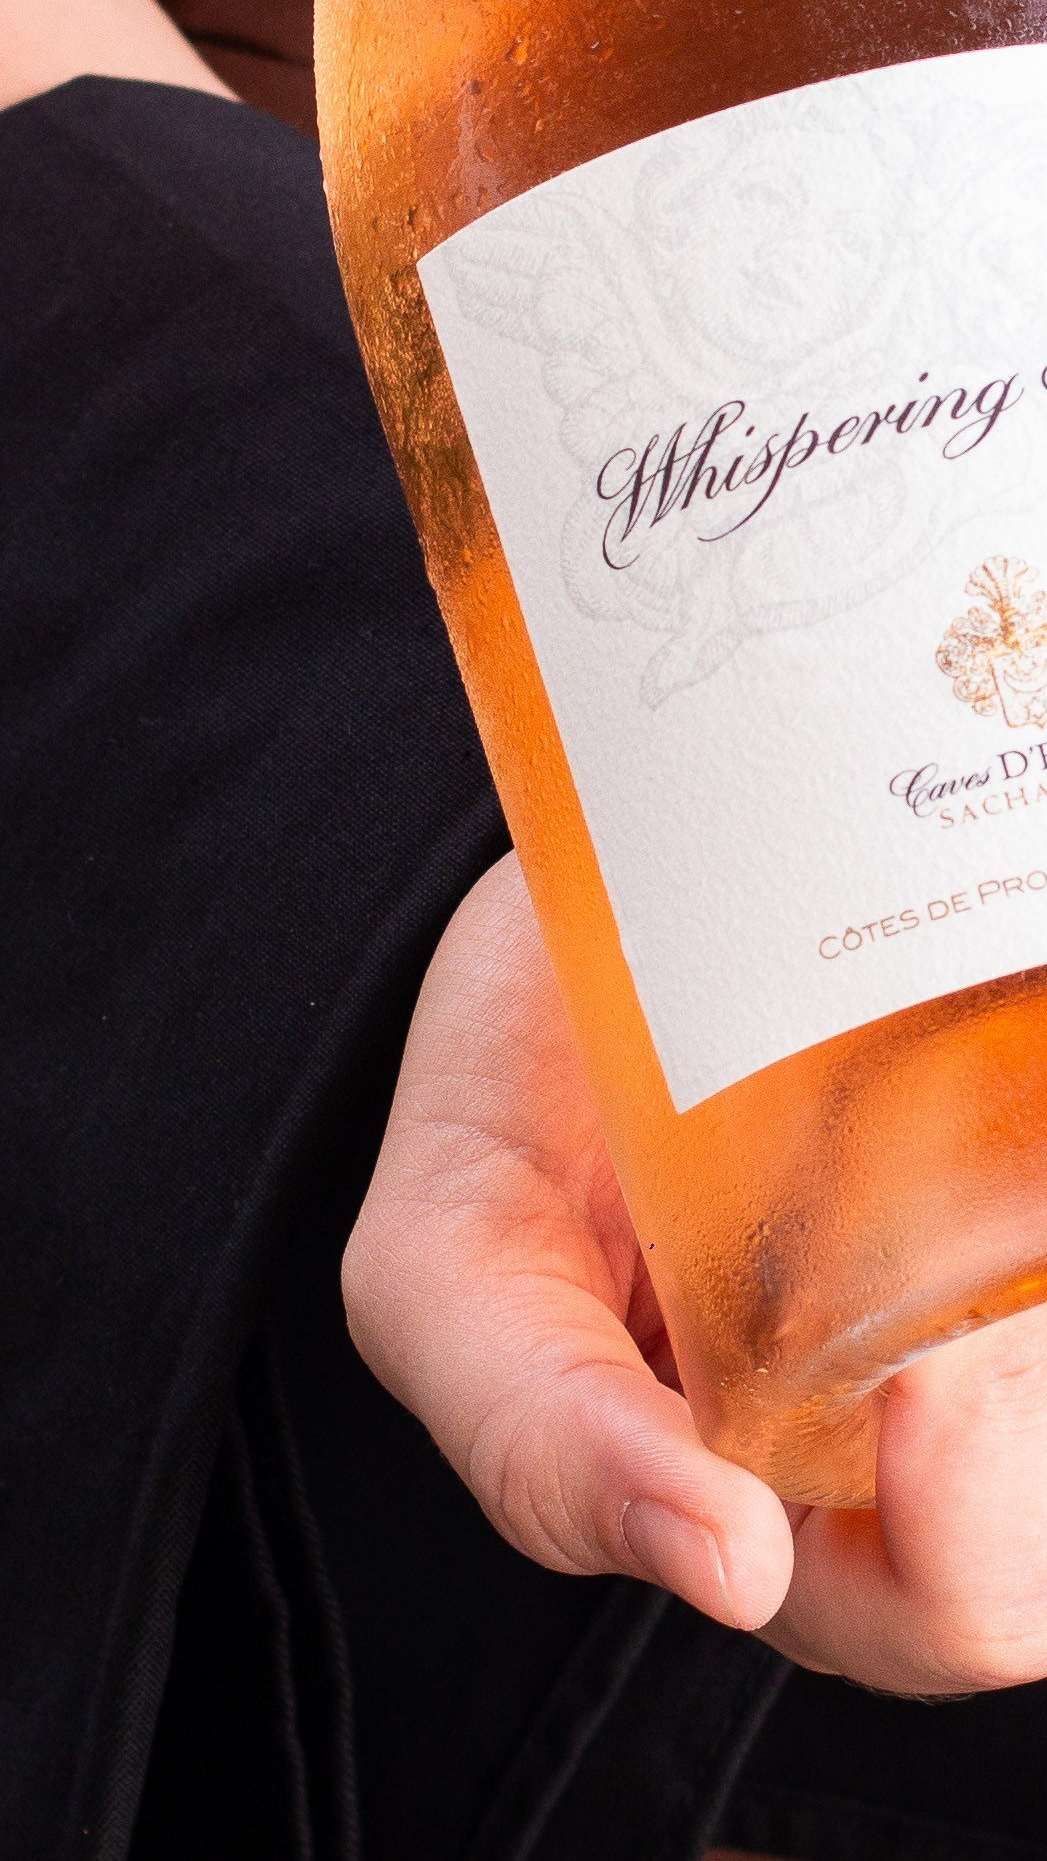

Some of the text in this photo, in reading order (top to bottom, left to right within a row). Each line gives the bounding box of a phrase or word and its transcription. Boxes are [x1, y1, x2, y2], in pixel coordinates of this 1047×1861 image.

[596, 371, 1024, 570] Whispering
[888, 762, 991, 818] Caves
[818, 909, 921, 960] CÔTES
[927, 891, 973, 922] DE
